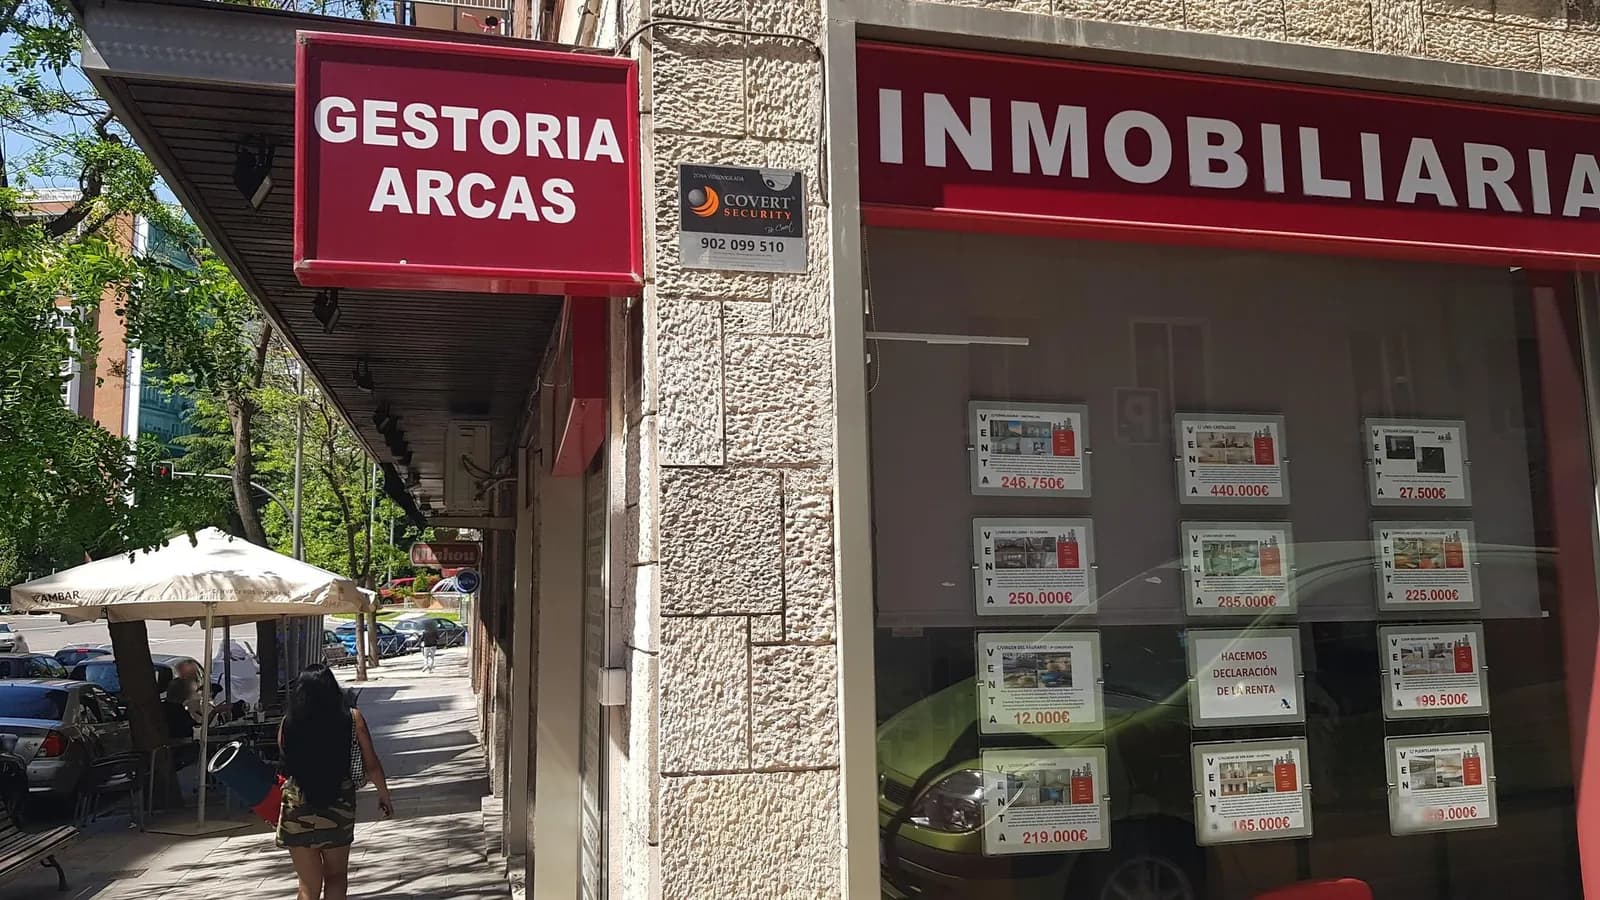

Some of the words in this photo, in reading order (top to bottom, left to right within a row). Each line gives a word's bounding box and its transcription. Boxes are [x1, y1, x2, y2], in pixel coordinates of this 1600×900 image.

[313, 95, 625, 164] GESTORIA
[878, 88, 1600, 218] INMOBILIARIA
[368, 166, 577, 225] ARCAS
[724, 193, 791, 209] COVERT
[723, 208, 792, 220] SECURITY
[701, 238, 726, 250] 902
[730, 239, 755, 251] 099
[759, 241, 784, 253] 510
[1001, 476, 1065, 489] 246.750€
[1210, 485, 1269, 497] 440.000€
[1400, 487, 1446, 499] 27.500€
[415, 547, 475, 561] Mahou
[40, 590, 80, 603] AMBAR
[1008, 591, 1073, 605] 250.000€
[1218, 595, 1277, 608] 285.000€
[1405, 589, 1459, 601] 225.000€
[1221, 651, 1268, 661] HACEMOS
[1213, 665, 1278, 678] DECLARACIÓN
[1217, 687, 1229, 696] DE
[1231, 686, 1244, 695] LA
[1245, 685, 1276, 695] RENTA
[1014, 711, 1070, 725] 12.000€
[1023, 829, 1088, 844] 219.000€
